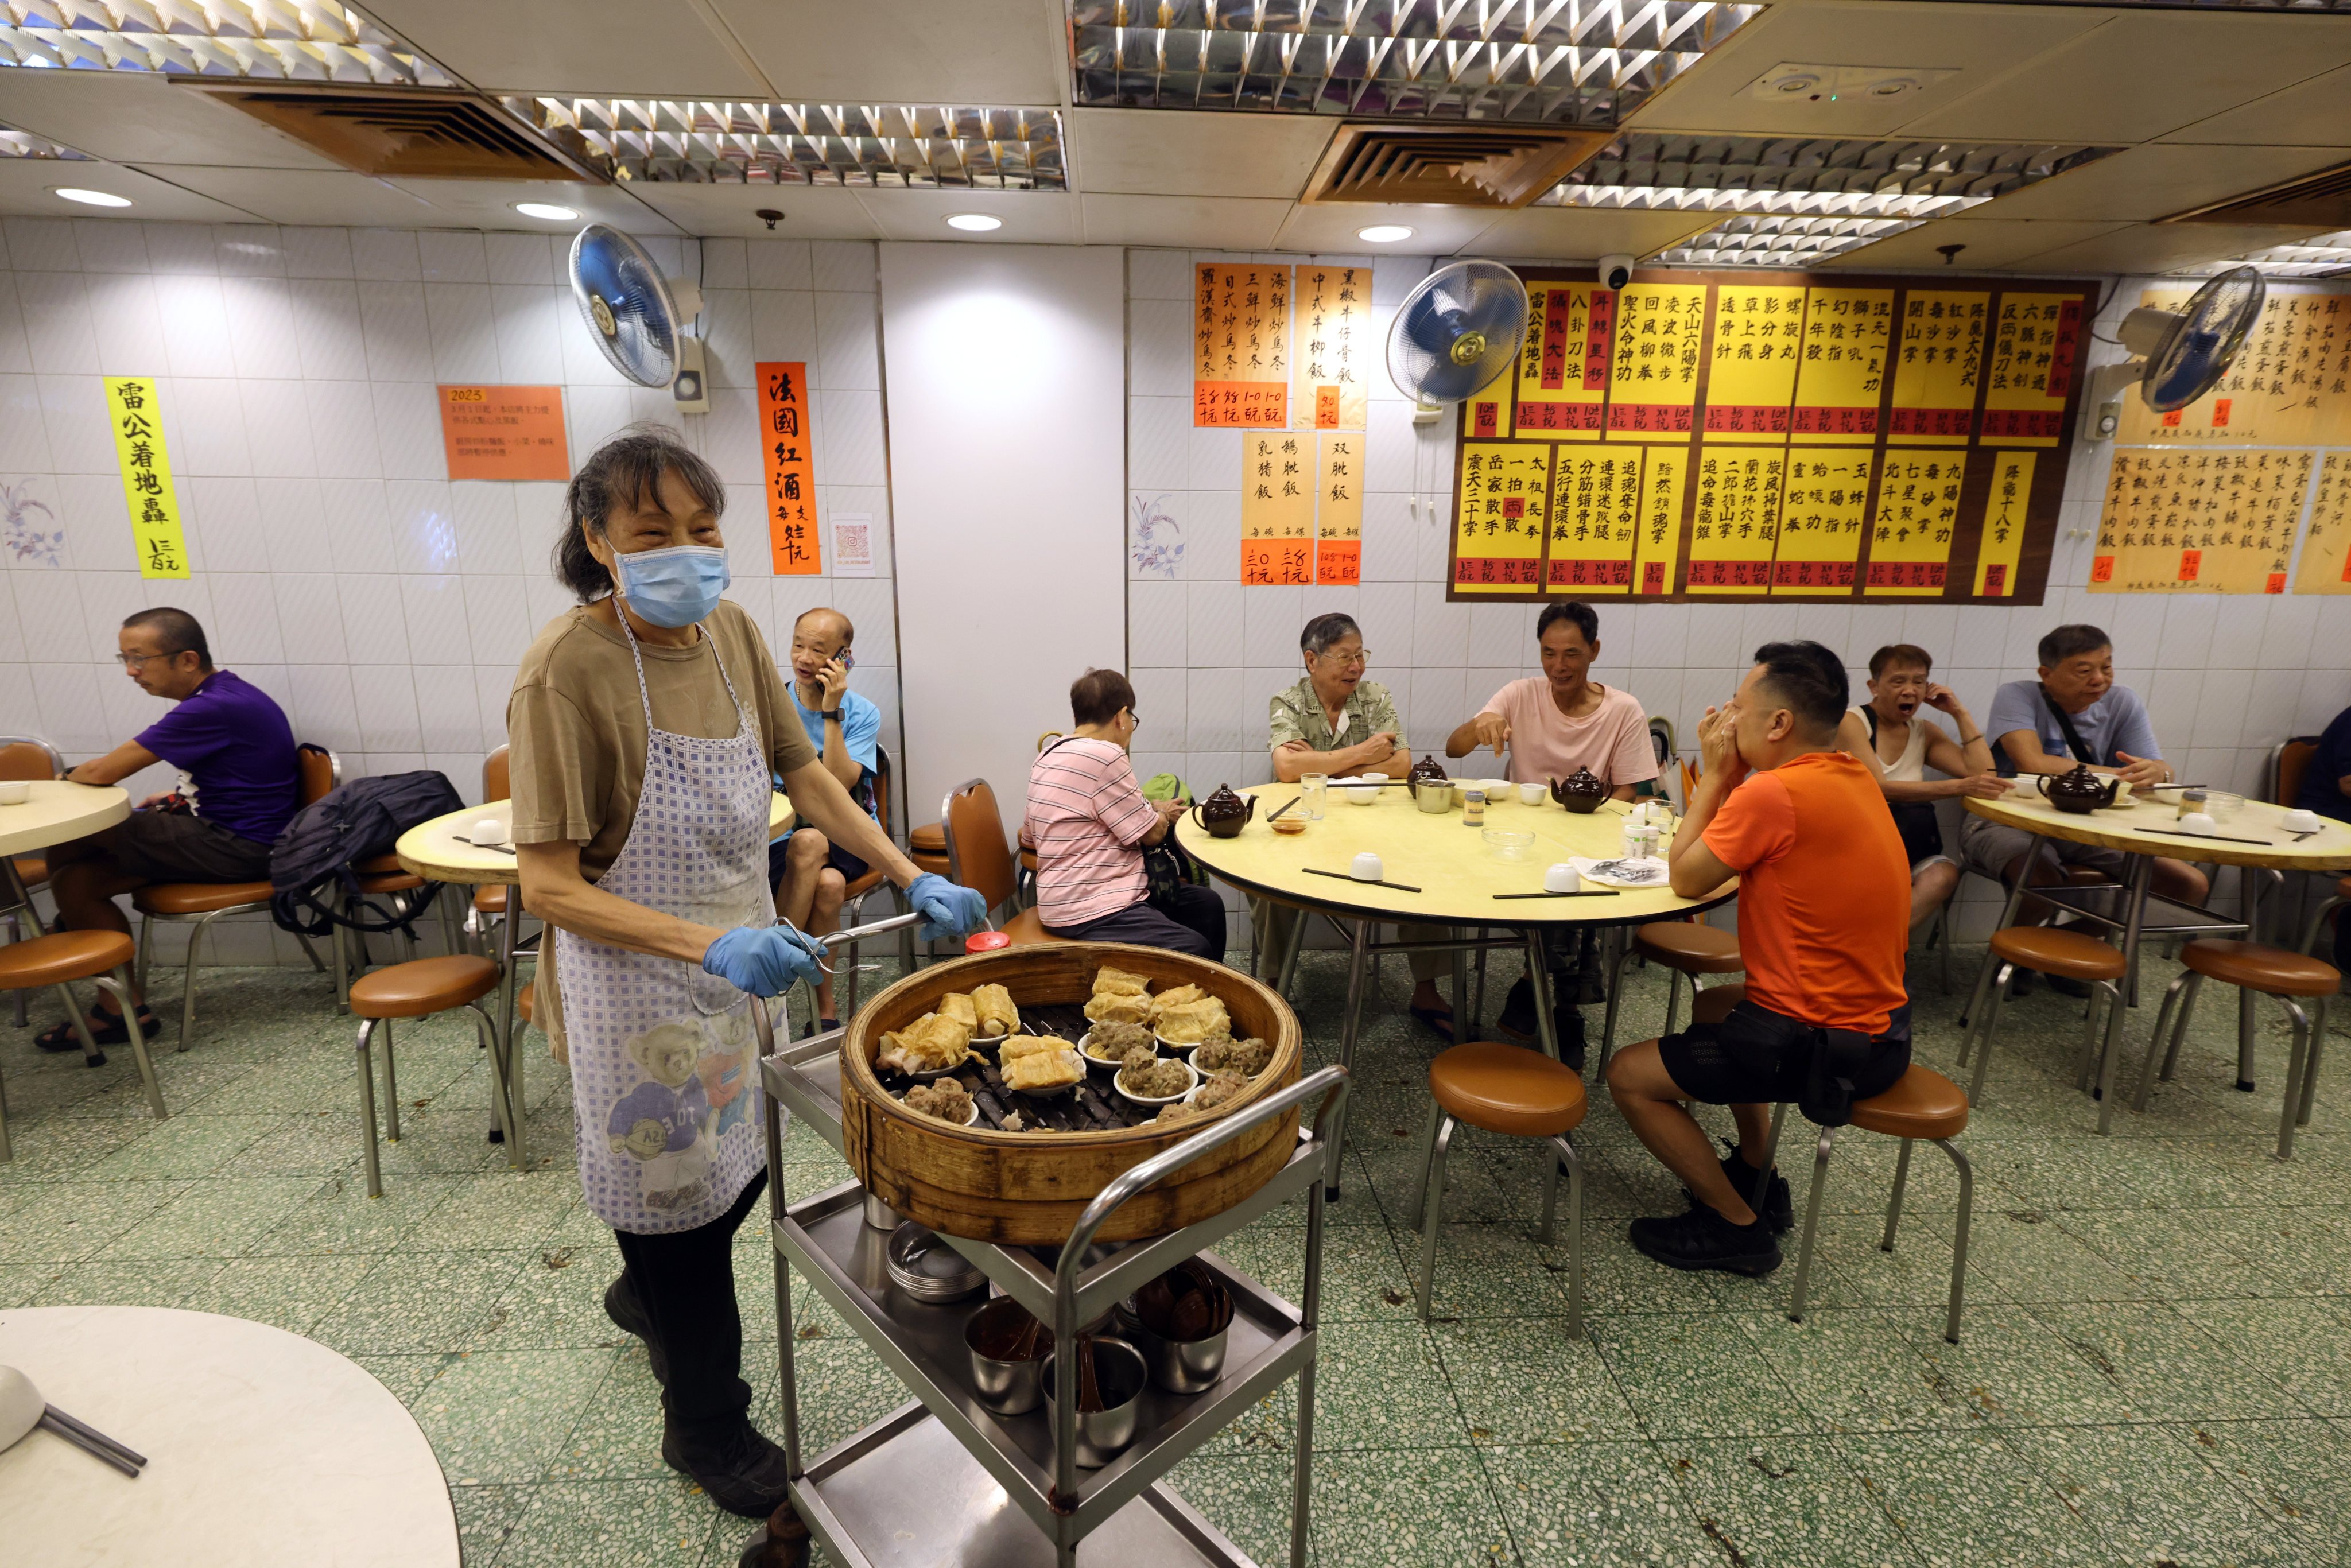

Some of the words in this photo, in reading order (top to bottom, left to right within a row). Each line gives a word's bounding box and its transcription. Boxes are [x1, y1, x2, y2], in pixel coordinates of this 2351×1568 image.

[1307, 272, 1326, 379] 中式牛柳飯
[1335, 270, 1357, 383] 黑椒牛仔骨飯
[1524, 292, 1546, 379] 雷公着地轟
[1567, 294, 1588, 379] 八卦刀法
[1588, 295, 1609, 381] 斗轉星移
[1616, 295, 1639, 381] 聖火令神功
[1659, 296, 1681, 381] 凌波微步
[1680, 296, 1702, 382] 天山六陽掌
[1716, 296, 1736, 359] 透骨針
[1737, 297, 1759, 360] 草上飛
[1759, 297, 1779, 359] 影分身
[1780, 298, 1802, 359] 螺旋丸
[1904, 300, 1925, 363] 開山掌
[117, 382, 169, 525] 雷公着地轟
[769, 372, 802, 501] 法國紅酒
[776, 505, 809, 521] 每支
[1463, 453, 1483, 537] 震天三十掌
[1484, 454, 1504, 536] 岳家散手
[1504, 459, 1524, 533] 一拍兩散
[1524, 457, 1546, 539] 太祖長拳
[1552, 459, 1574, 541] 五行連環拳
[1574, 459, 1596, 541] 分筋錯骨手
[1593, 459, 1615, 540] 連環迷蹤腿
[1651, 463, 1673, 544] 黯然銷魂掌
[1696, 459, 1719, 540] 追命毒龍錐
[1718, 461, 1740, 539] 二郎擔山掌
[1737, 459, 1759, 538] 蘭花拂穴手
[1758, 460, 1782, 541] 旋風掃葉腿
[1784, 462, 1806, 533] 靈蛇拳
[1806, 463, 1829, 530] 蛤蟆功
[1825, 467, 1848, 533] 一陽指
[1844, 463, 1868, 533] 玉蜂針
[1875, 463, 1900, 542] 北斗大陣
[1896, 463, 1920, 542] 七星聚會
[1935, 463, 1961, 542] 九陽神功
[1995, 465, 2020, 544] 降龍十八掌
